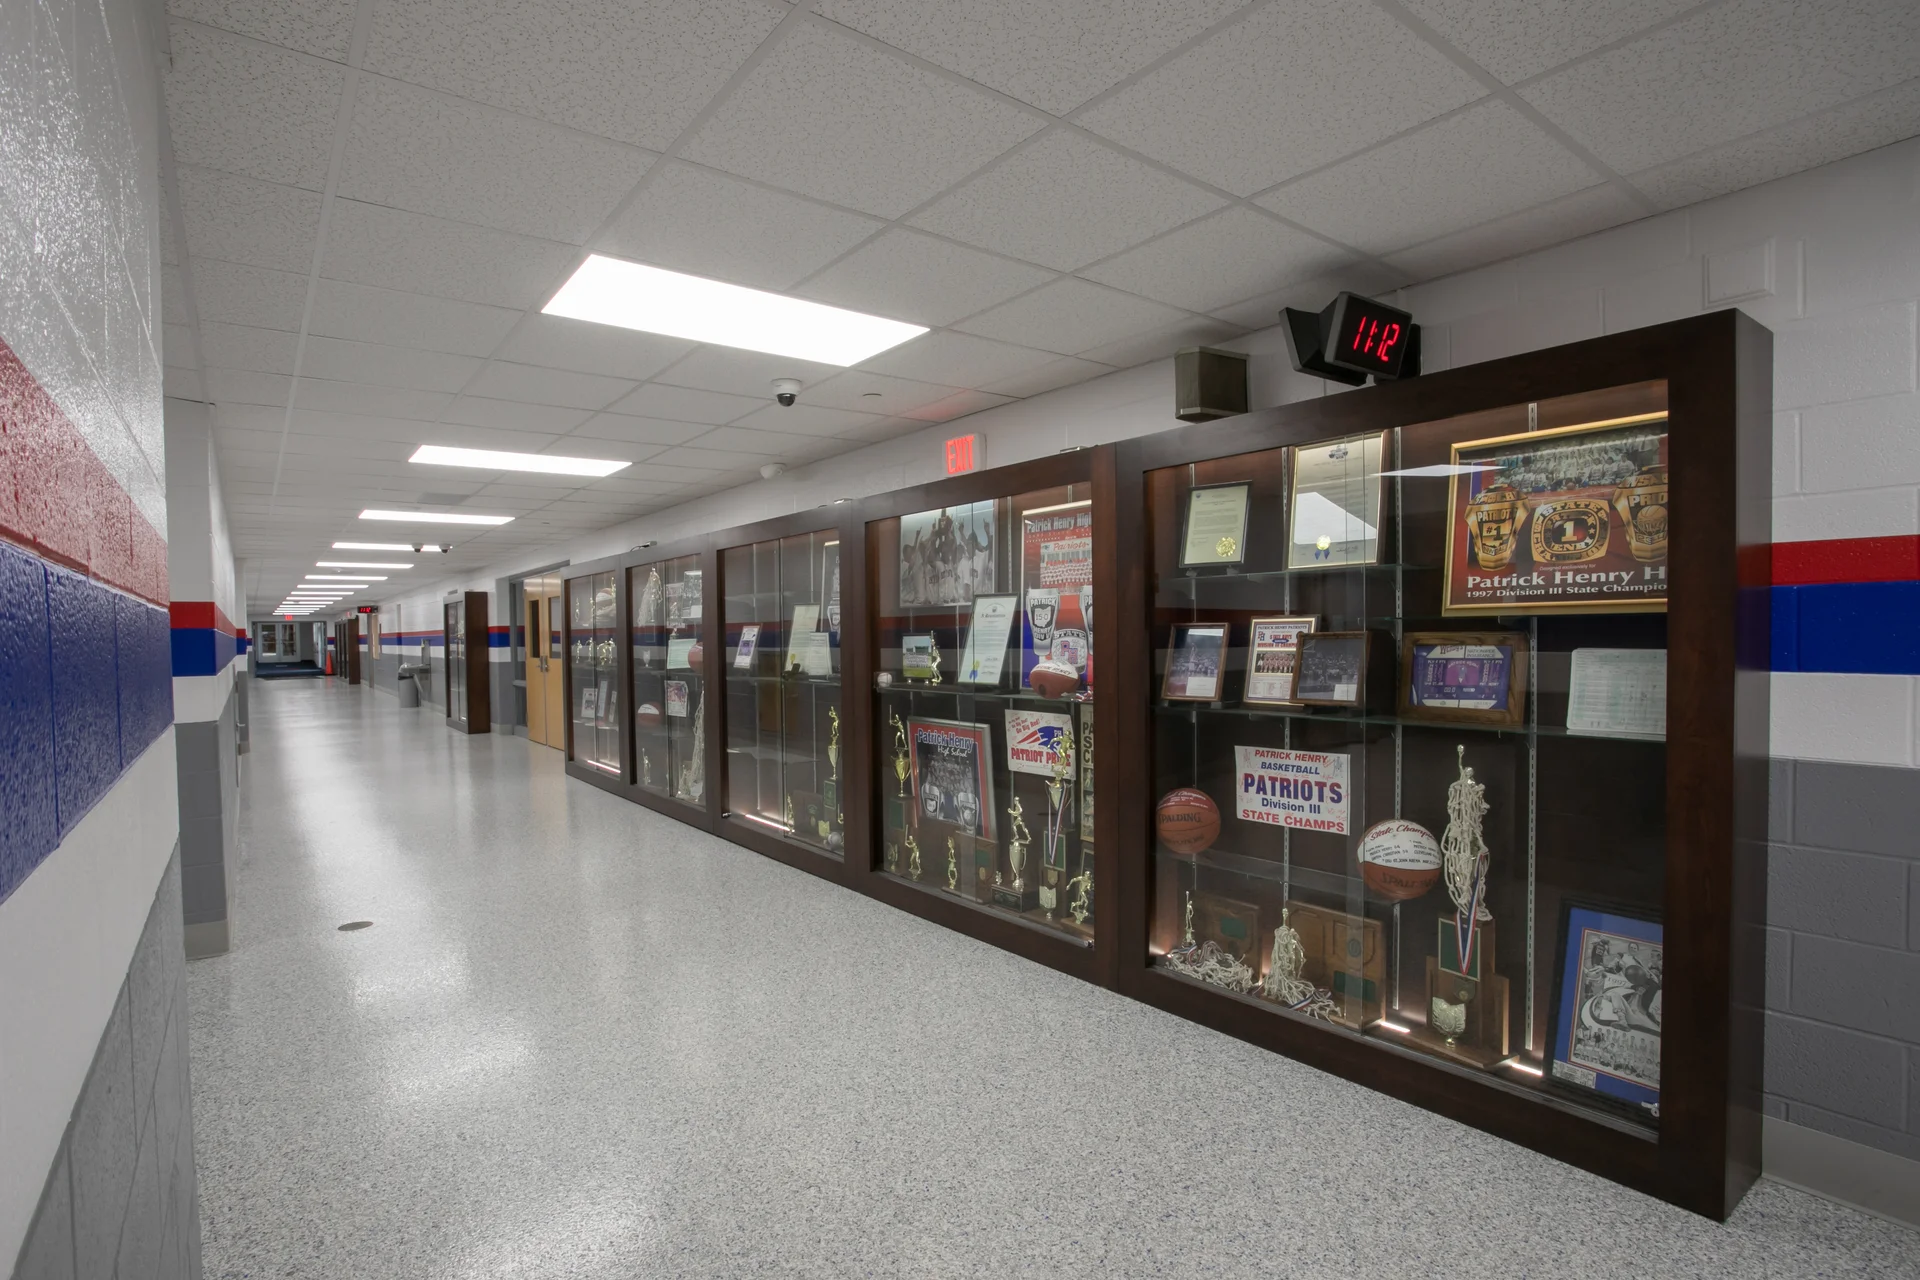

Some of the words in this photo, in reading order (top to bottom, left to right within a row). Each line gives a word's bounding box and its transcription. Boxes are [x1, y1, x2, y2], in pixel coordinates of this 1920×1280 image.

[1353, 316, 1400, 362] 11:12
[1026, 518, 1052, 533] Patrick
[1053, 516, 1075, 530] Henry
[1467, 572, 1546, 589] Patrick
[1554, 571, 1635, 586] Henry
[1643, 565, 1666, 580] H
[1466, 590, 1494, 598] 1997
[1496, 588, 1545, 597] Division
[1566, 585, 1599, 594] State
[1030, 598, 1057, 606] PATRICK
[1035, 613, 1049, 621] 15-0
[1053, 630, 1086, 639] STATE
[917, 728, 948, 747] Patrick
[948, 732, 974, 753] Henry
[1011, 748, 1044, 763] PATRIOT
[1046, 752, 1071, 767] PRIE
[1254, 749, 1292, 760] PATRICK
[1294, 753, 1329, 763] HENRY
[1261, 761, 1320, 775] BASKETBALL
[1243, 773, 1343, 804] PATRIOTS
[1261, 797, 1305, 813] Division
[1309, 803, 1321, 815] III
[1242, 809, 1280, 824] STATE
[1283, 815, 1345, 833] CHAMPS
[1369, 826, 1395, 841] State
